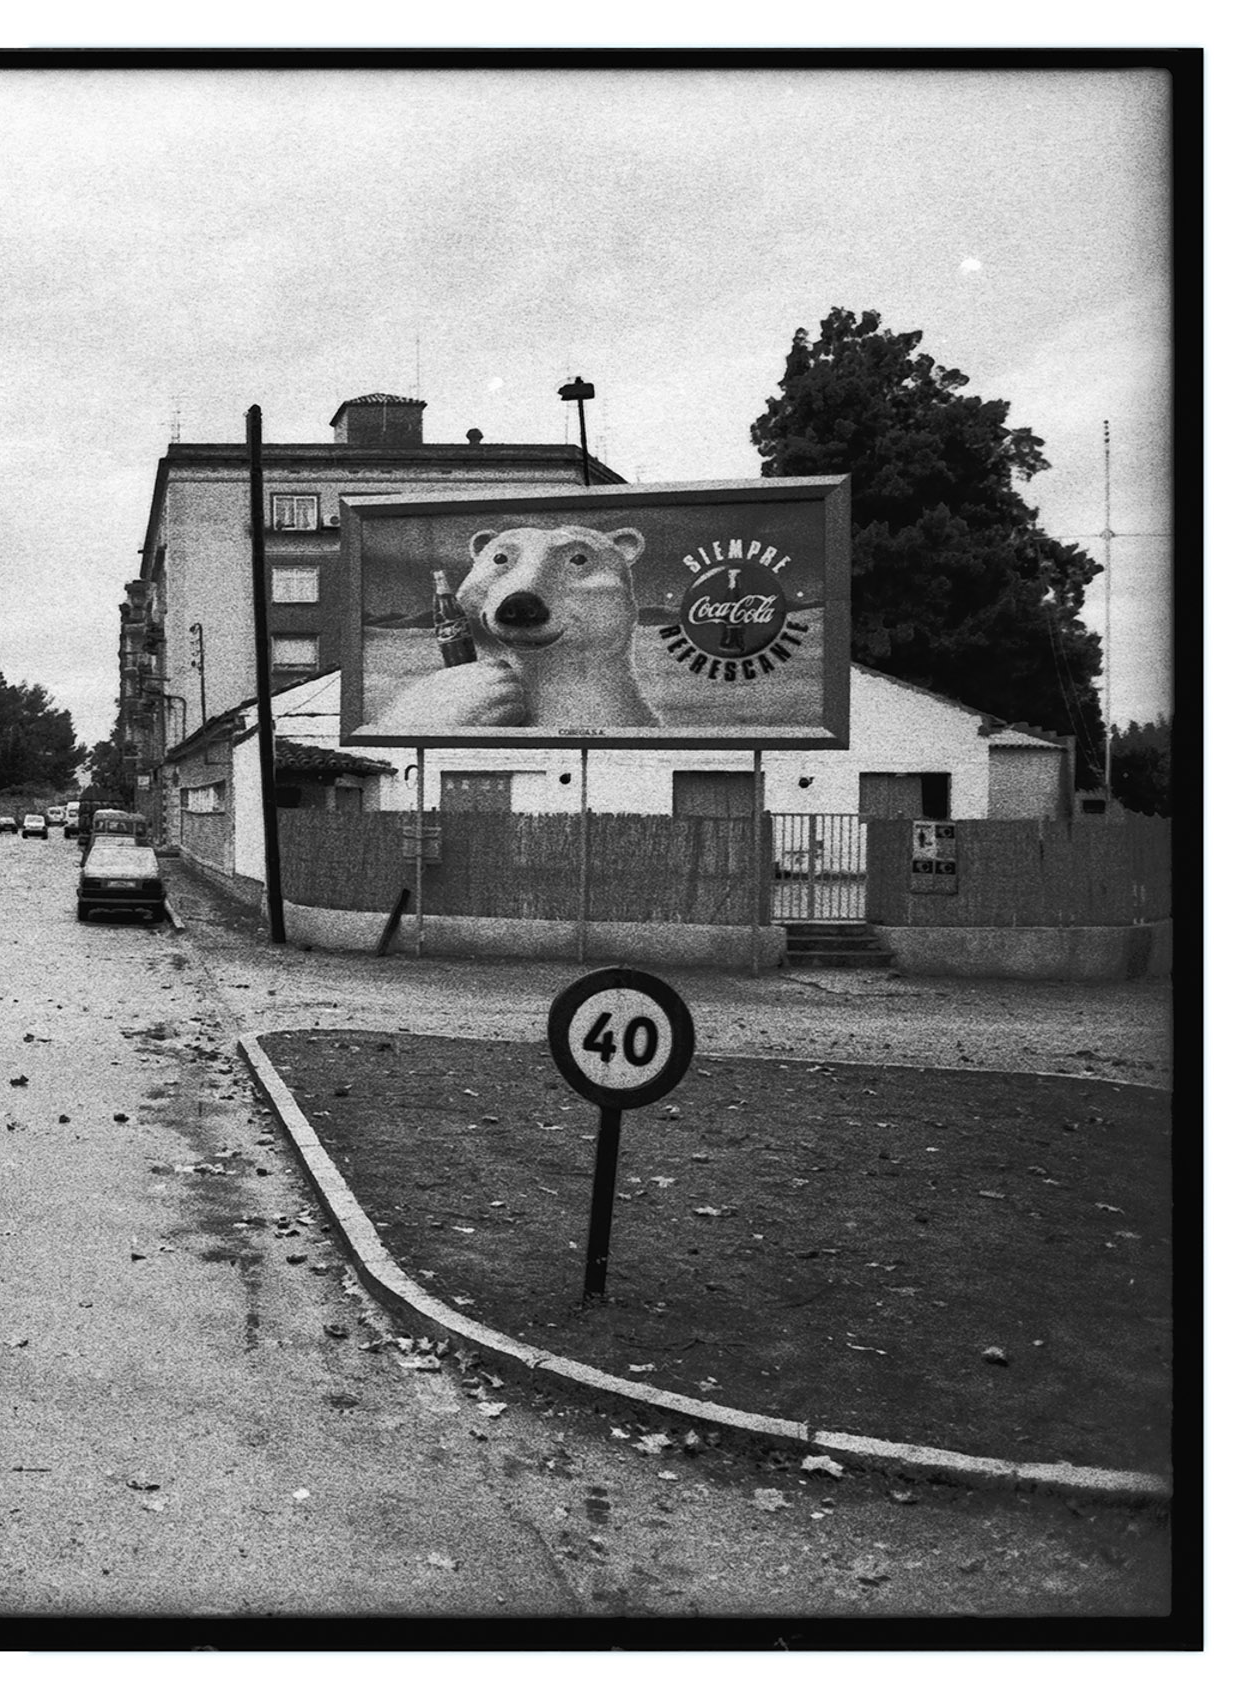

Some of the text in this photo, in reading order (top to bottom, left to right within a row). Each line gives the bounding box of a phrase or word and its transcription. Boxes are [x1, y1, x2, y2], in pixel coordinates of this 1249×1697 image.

[683, 539, 791, 573] SIEMPRE
[688, 594, 779, 624] Coca-Cola
[659, 620, 809, 682] REFRESCANTE
[583, 1012, 658, 1067] 40
